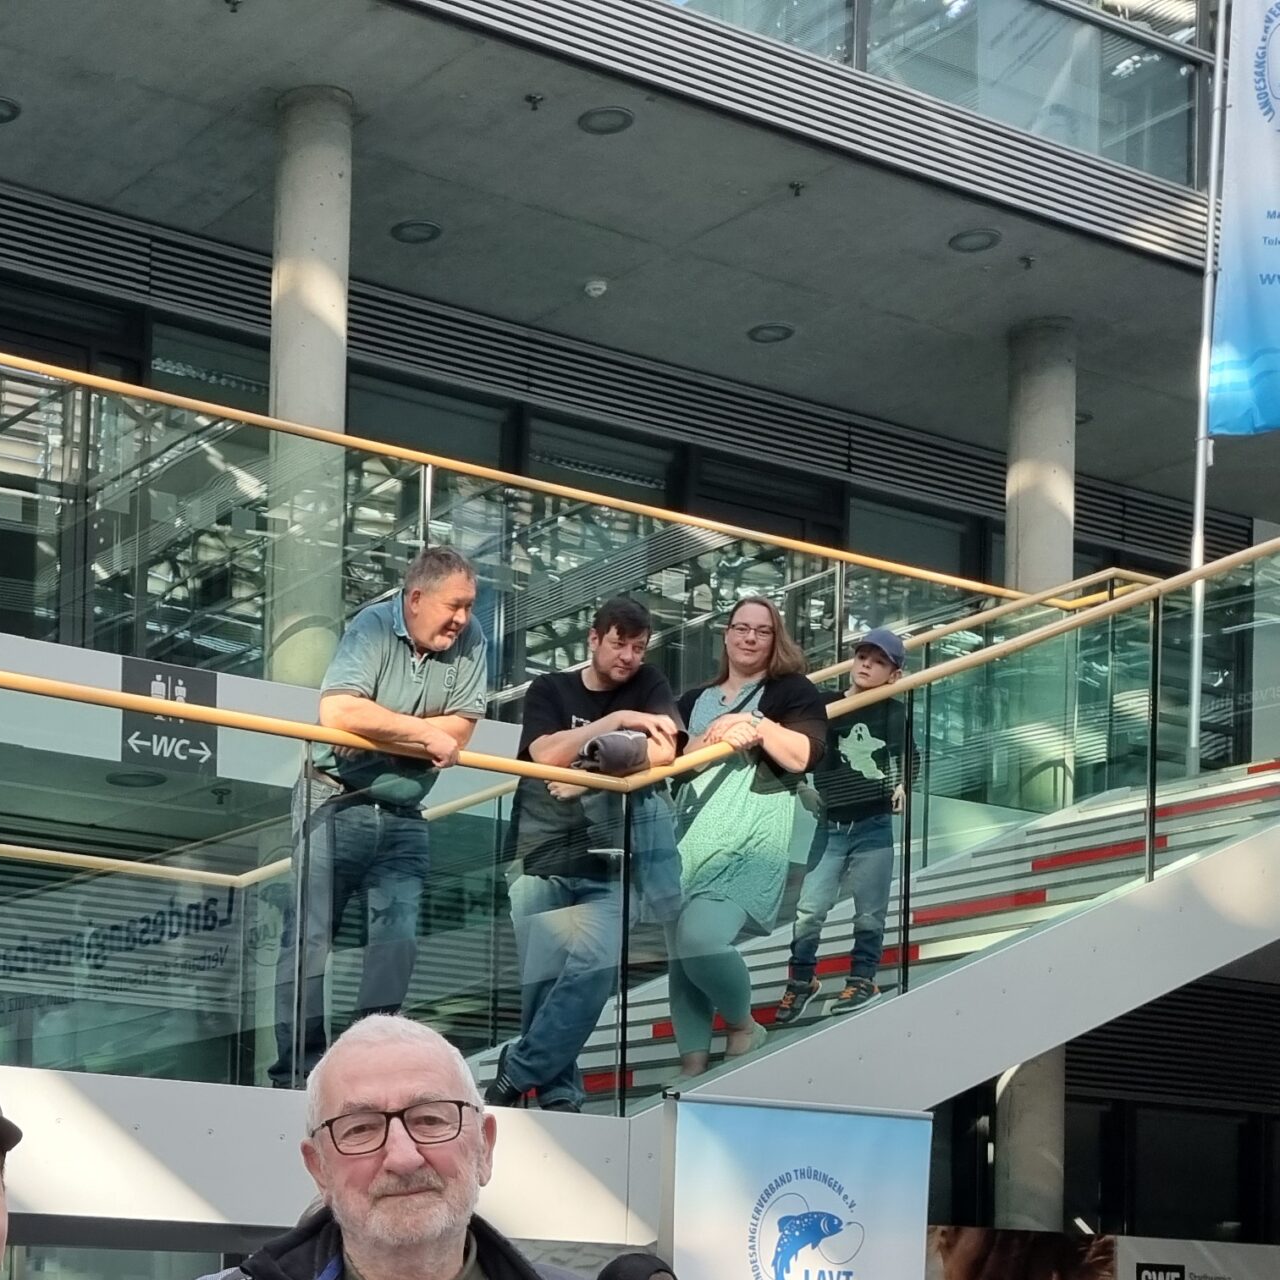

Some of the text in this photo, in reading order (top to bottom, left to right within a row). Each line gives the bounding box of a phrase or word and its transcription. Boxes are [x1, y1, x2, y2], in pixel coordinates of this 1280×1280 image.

[152, 734, 190, 761] WC
[793, 1166, 845, 1196] THÜRINGEN
[842, 1193, 857, 1213] e.V.
